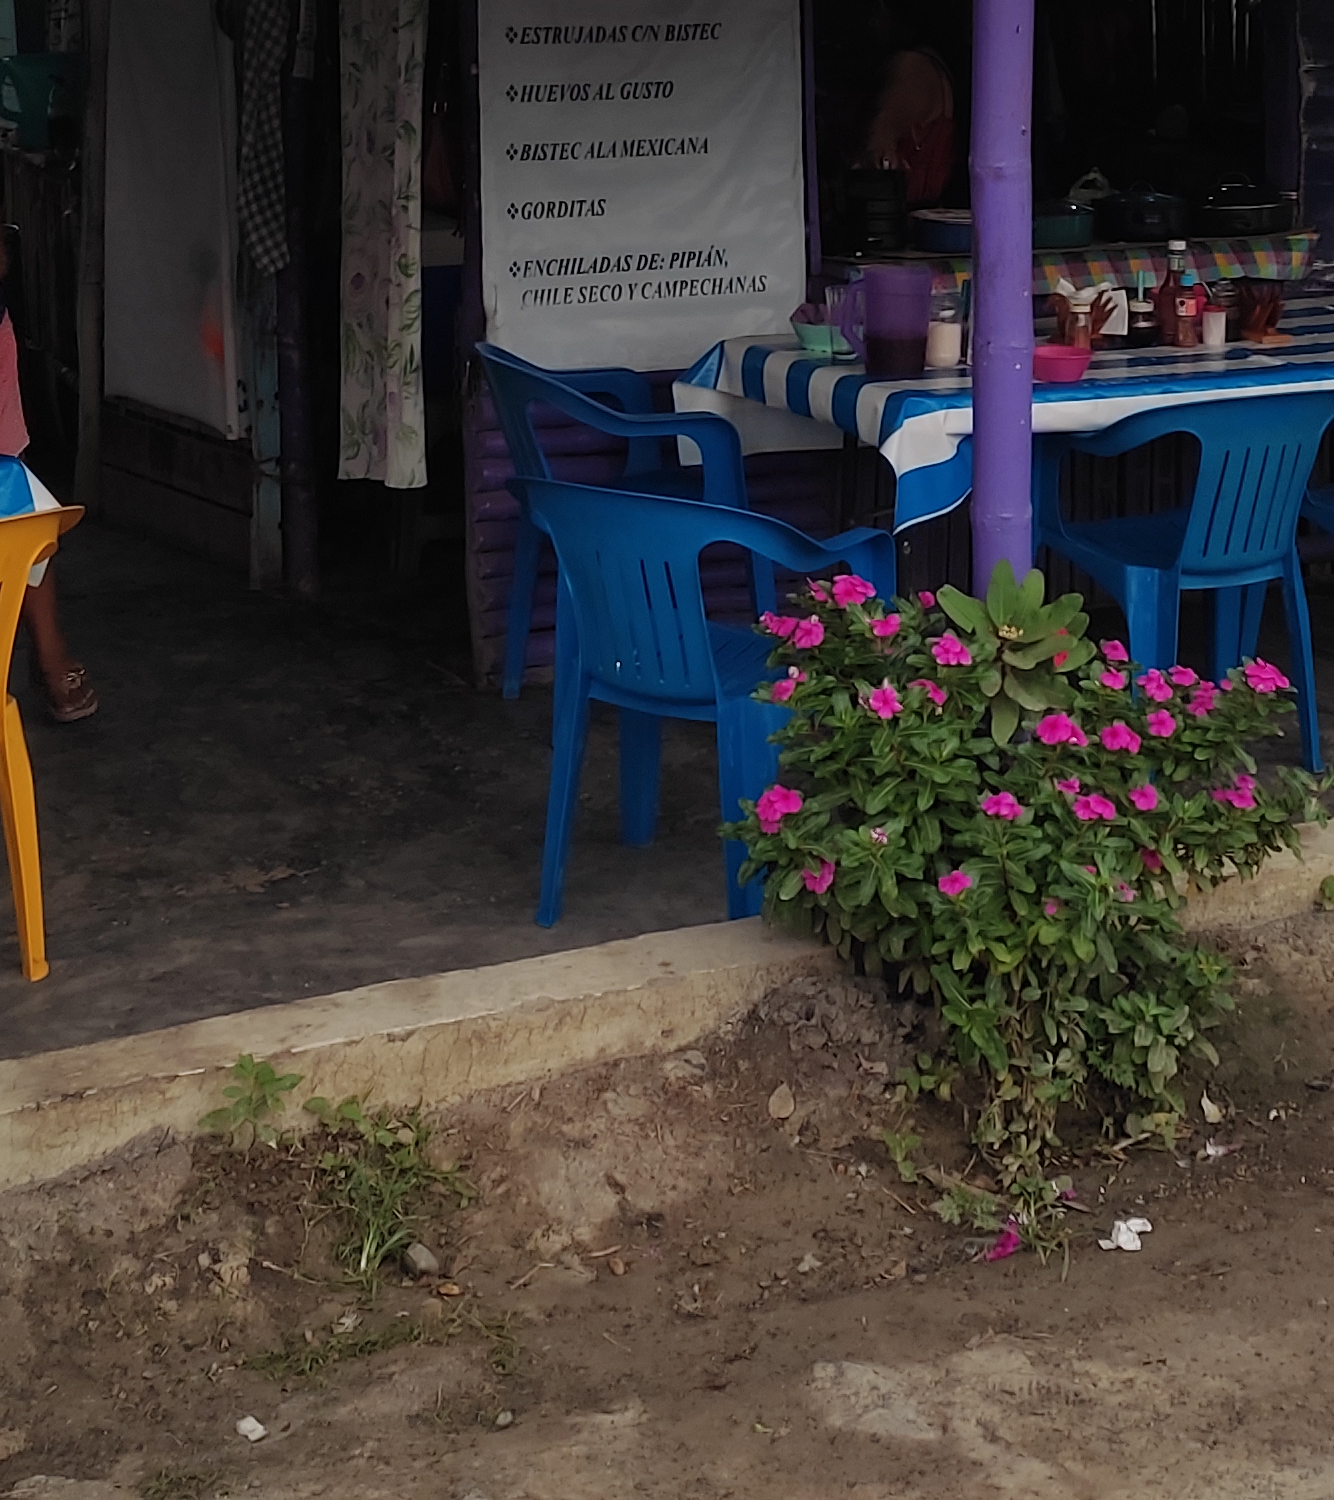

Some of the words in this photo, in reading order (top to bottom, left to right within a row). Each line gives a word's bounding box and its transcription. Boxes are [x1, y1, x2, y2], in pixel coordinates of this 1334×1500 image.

[520, 26, 628, 45] ESTRUJADAS
[665, 23, 722, 42] BISTEC
[520, 83, 591, 103] HUEVOS
[593, 82, 616, 101] AL
[620, 80, 674, 100] GUSTO
[520, 142, 582, 161] BISTEC
[620, 137, 709, 158] MEXICANA
[521, 198, 607, 220] GORDITAS
[523, 254, 633, 278] ENCHILADAS
[636, 253, 665, 271] DE:
[669, 245, 729, 270] PIPIÁN,
[522, 287, 574, 308] CHILE
[578, 283, 623, 304] SECO
[628, 282, 639, 301] Y
[641, 274, 768, 301] CAMPECHANAS
